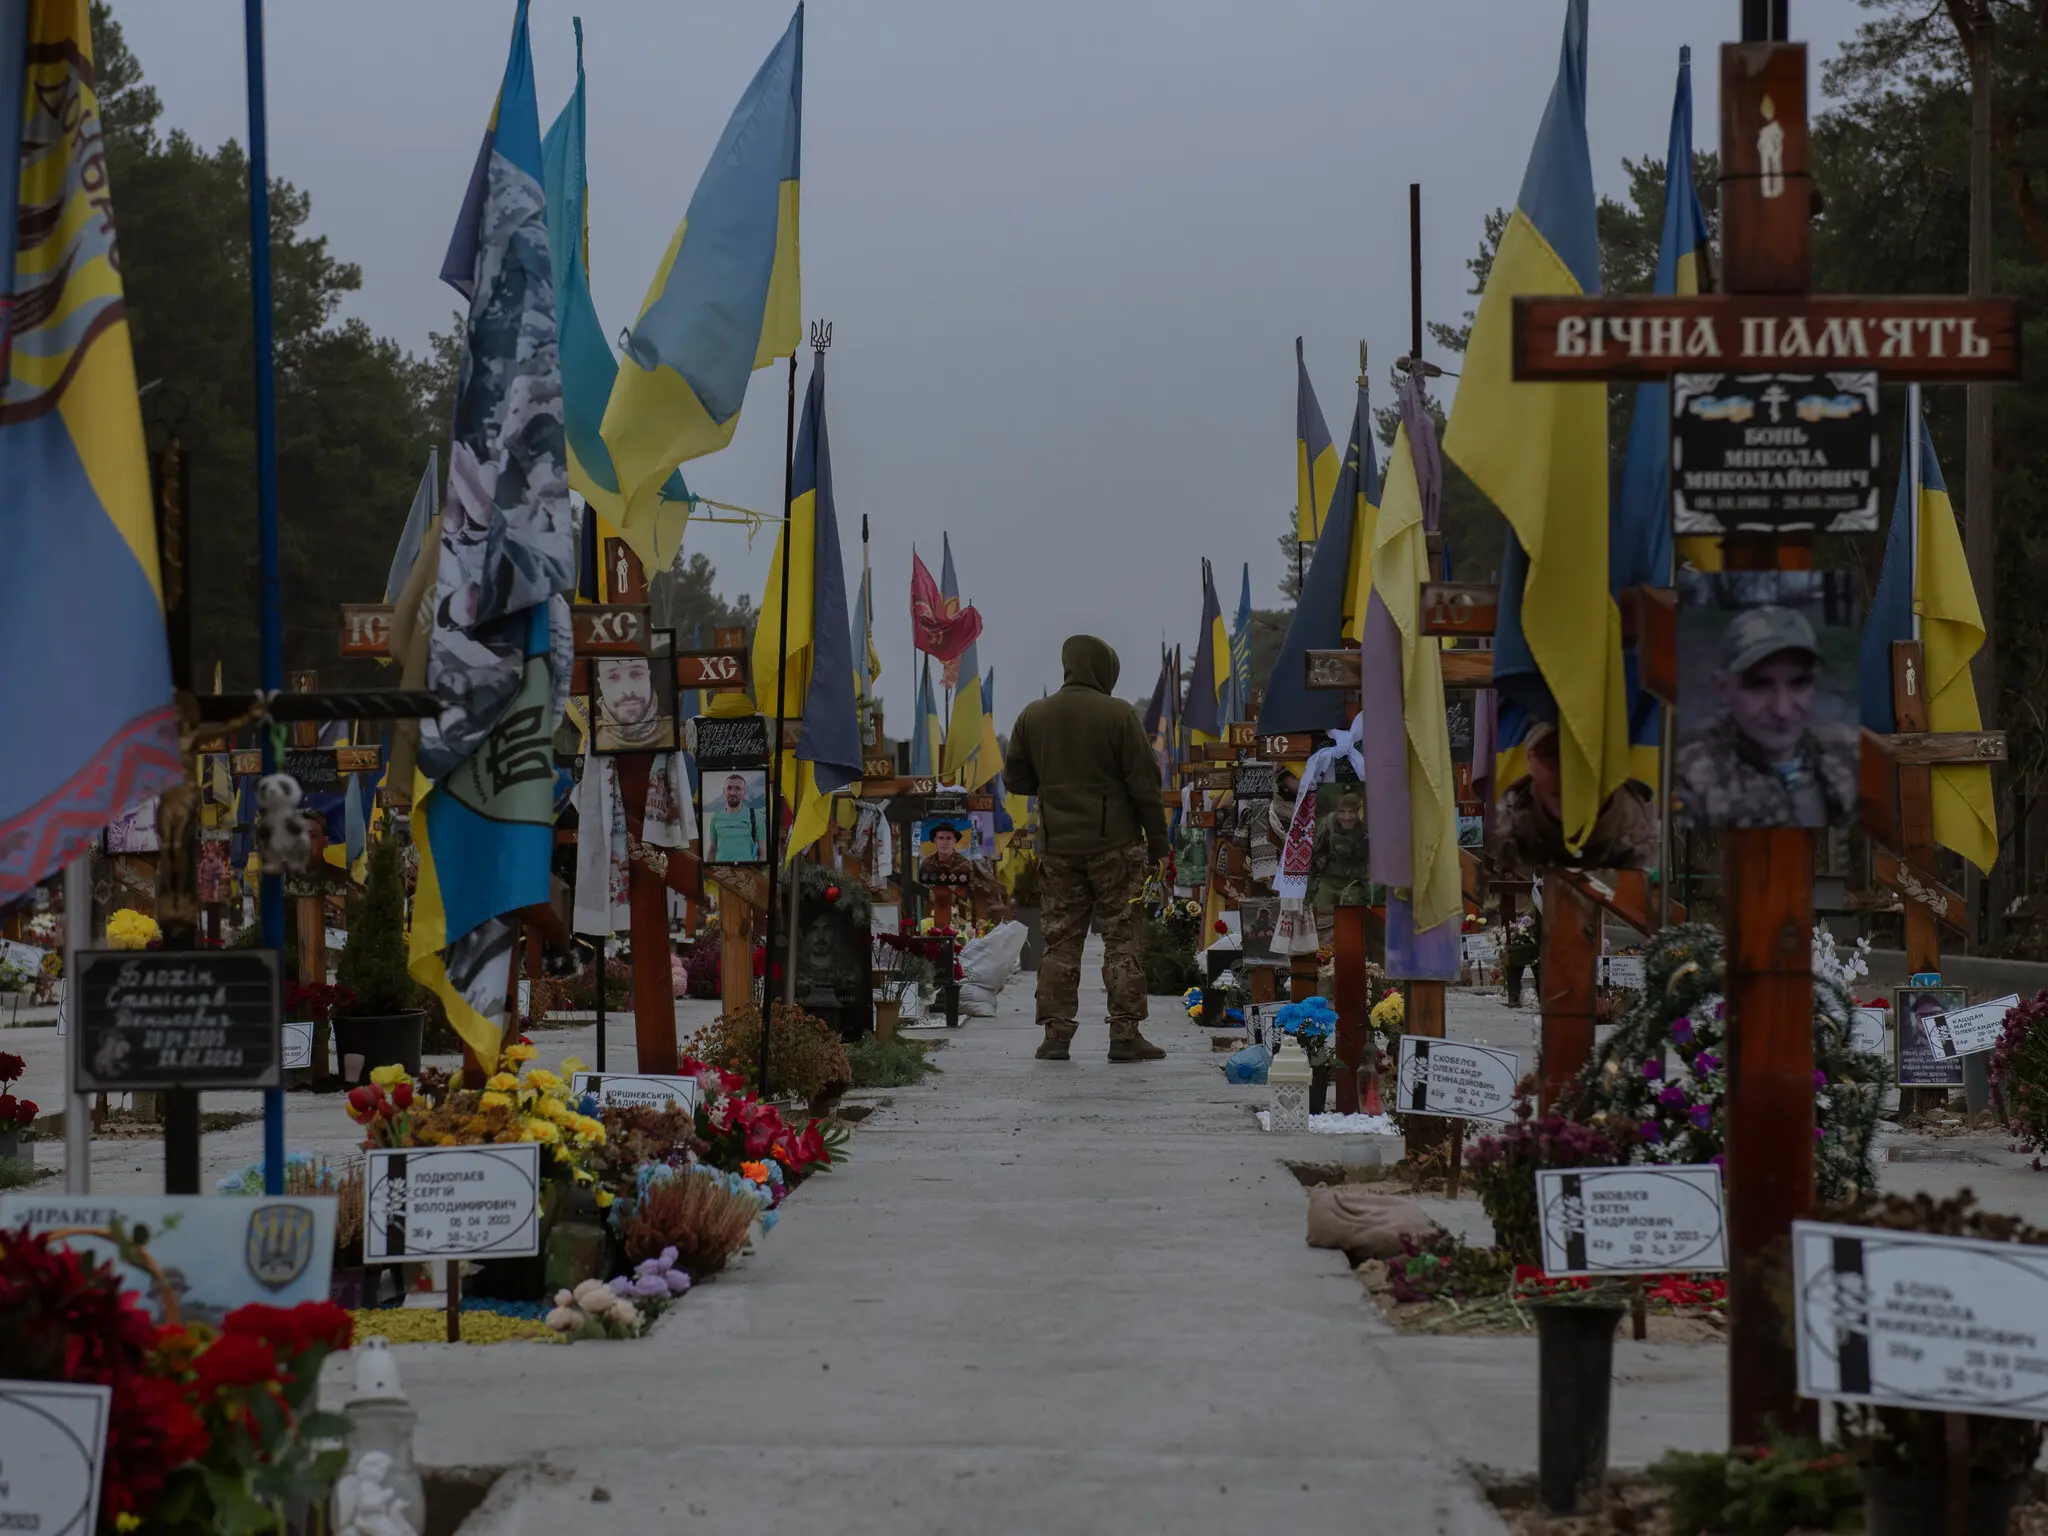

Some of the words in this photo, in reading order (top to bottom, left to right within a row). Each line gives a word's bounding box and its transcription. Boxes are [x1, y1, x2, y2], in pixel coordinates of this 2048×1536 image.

[1554, 314, 1722, 358] ВІЧНА
[1723, 449, 1829, 468] МИКОЛА
[1684, 468, 1870, 490] МИКОЛАЙОВИЧ
[698, 656, 738, 681] ХС
[1954, 1021, 2002, 1036] ОЛЕКСАНДРО
[414, 1185, 455, 1198] СЕРГІЙ
[414, 1200, 516, 1214] ВОЛОДИМИРОВИЧ
